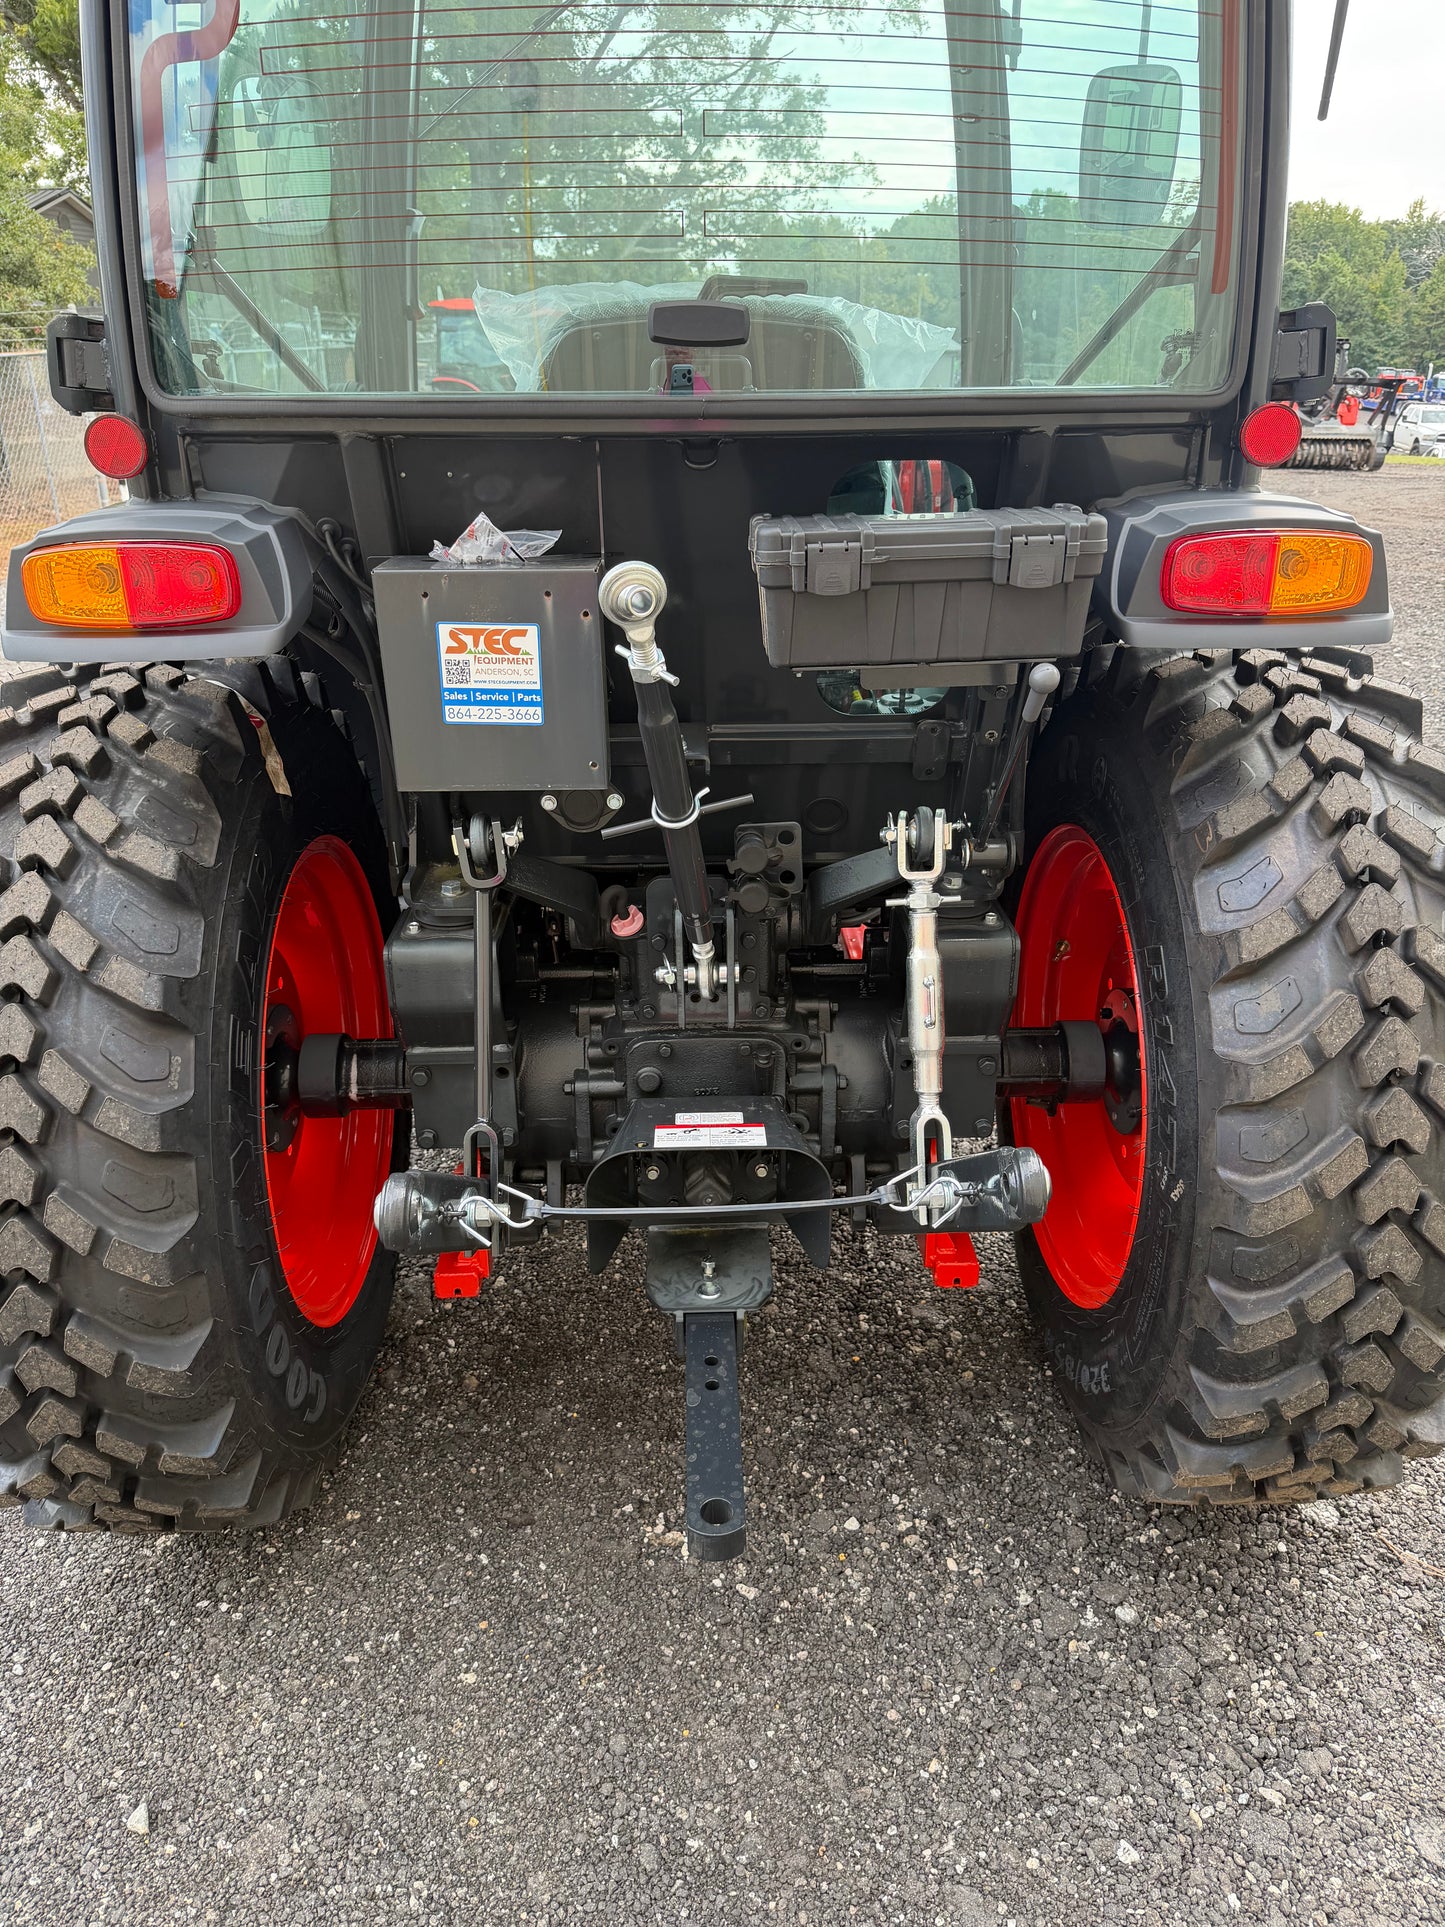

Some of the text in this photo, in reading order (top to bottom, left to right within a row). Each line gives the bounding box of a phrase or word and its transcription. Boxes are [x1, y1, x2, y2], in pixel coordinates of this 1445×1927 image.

[445, 627, 529, 656] STEC
[477, 656, 535, 666] EQUIPMENT
[475, 668, 522, 677] ANDERSON,
[443, 691, 542, 702] Sales Service Parts
[447, 707, 540, 721] 864-225-3666
